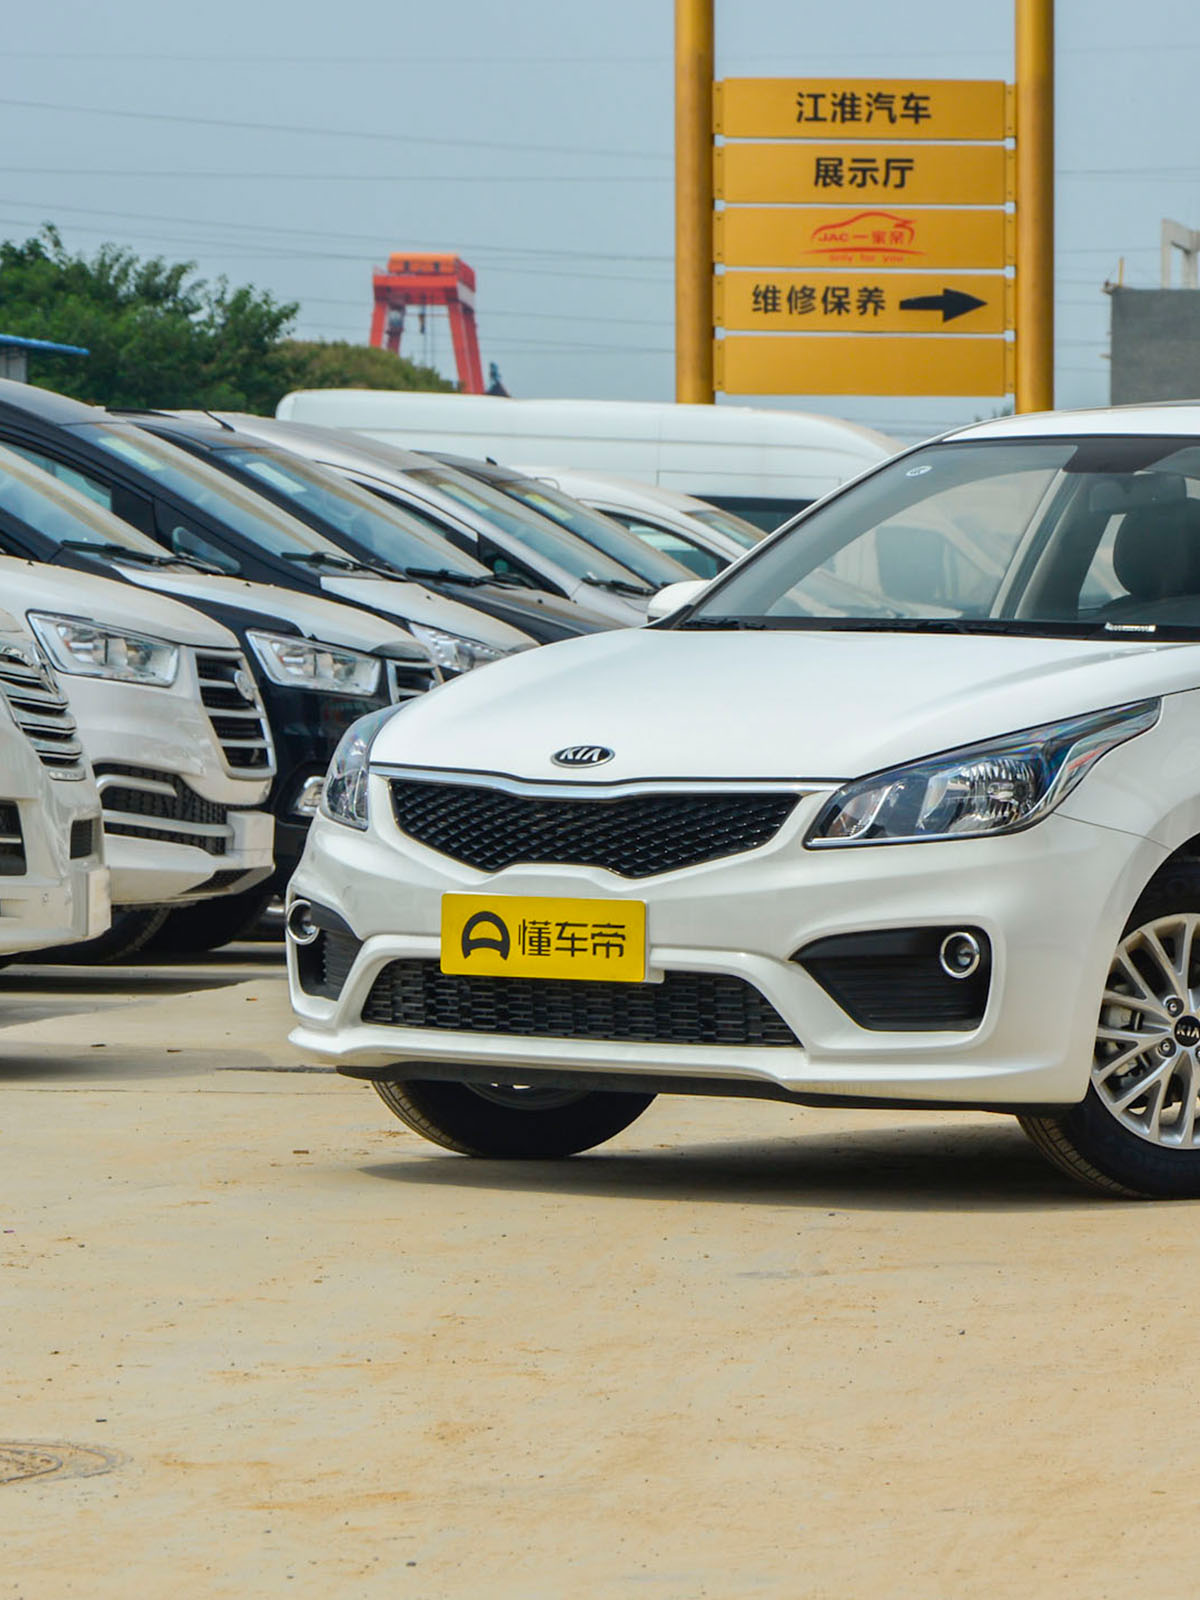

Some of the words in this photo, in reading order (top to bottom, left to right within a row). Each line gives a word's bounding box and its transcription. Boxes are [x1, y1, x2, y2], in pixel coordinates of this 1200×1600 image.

[796, 91, 931, 124] 江淮汽车
[813, 157, 914, 188] 展示厅
[752, 284, 886, 316] 维修保养
[560, 747, 602, 762] KIA
[518, 918, 626, 959] 懂车帝
[1176, 1025, 1200, 1039] KIA
